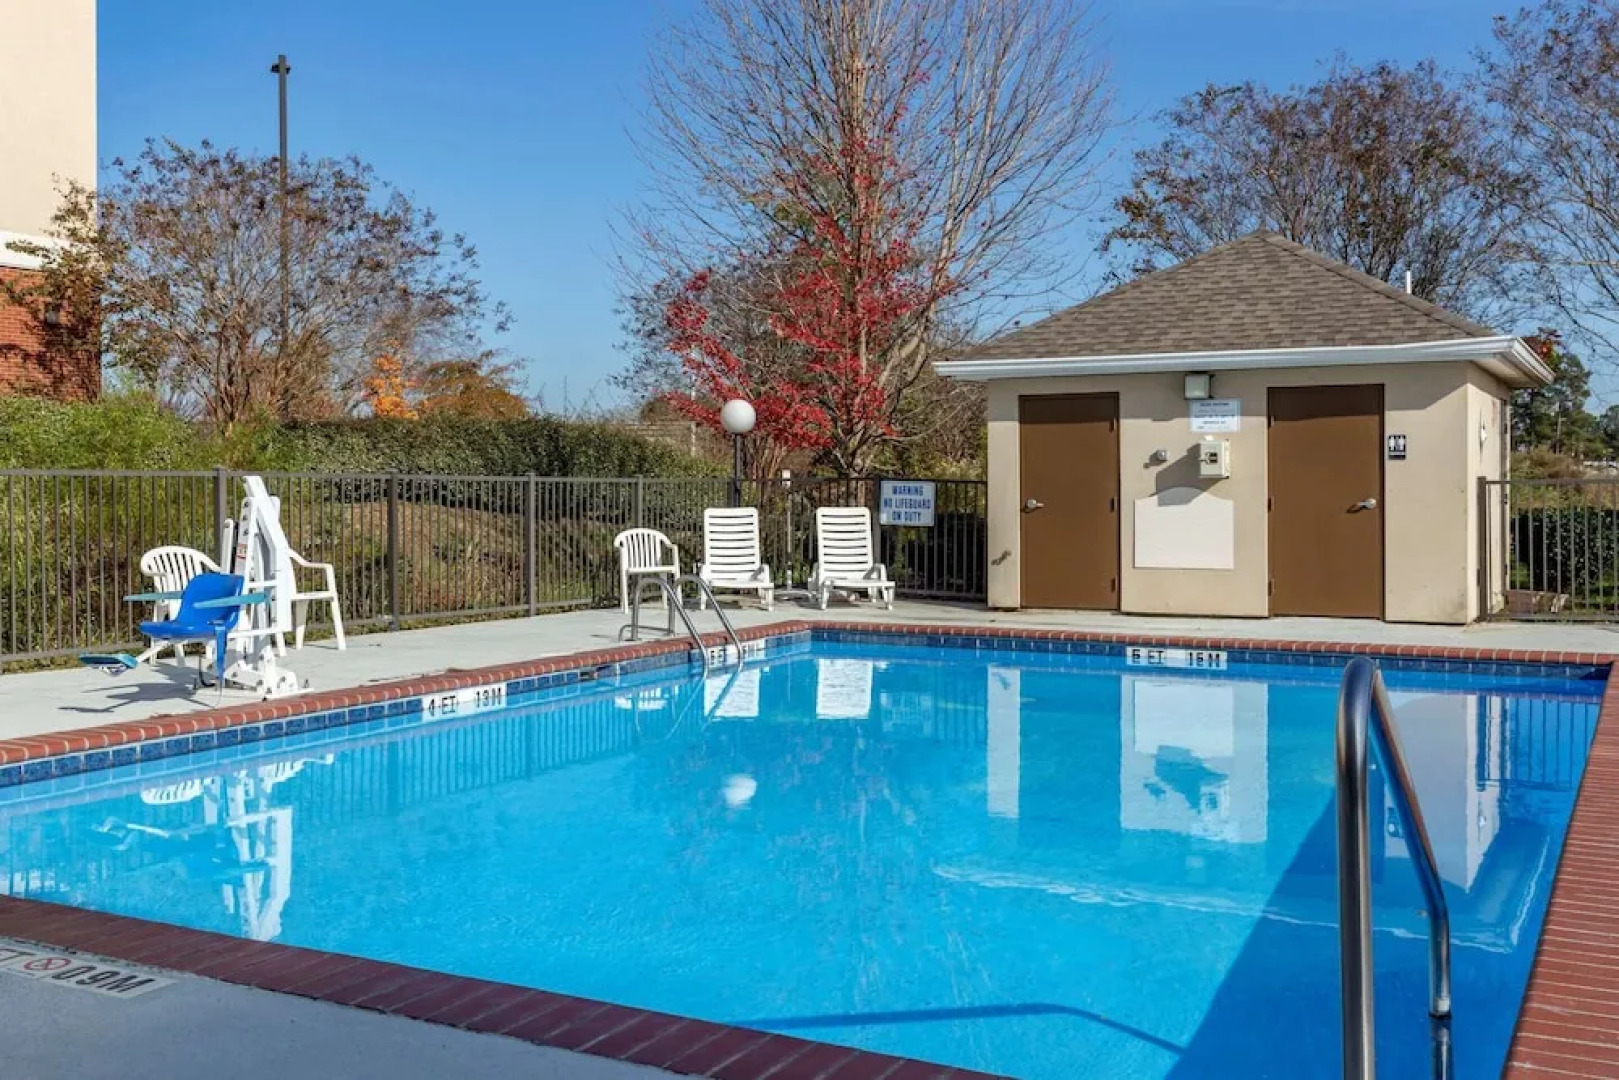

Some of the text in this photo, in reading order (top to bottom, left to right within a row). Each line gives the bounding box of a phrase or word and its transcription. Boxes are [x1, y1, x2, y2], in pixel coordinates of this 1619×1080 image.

[892, 485, 924, 496] WARNING
[883, 498, 931, 509] NO LIFEGUARD
[892, 511, 921, 522] ON DUTY
